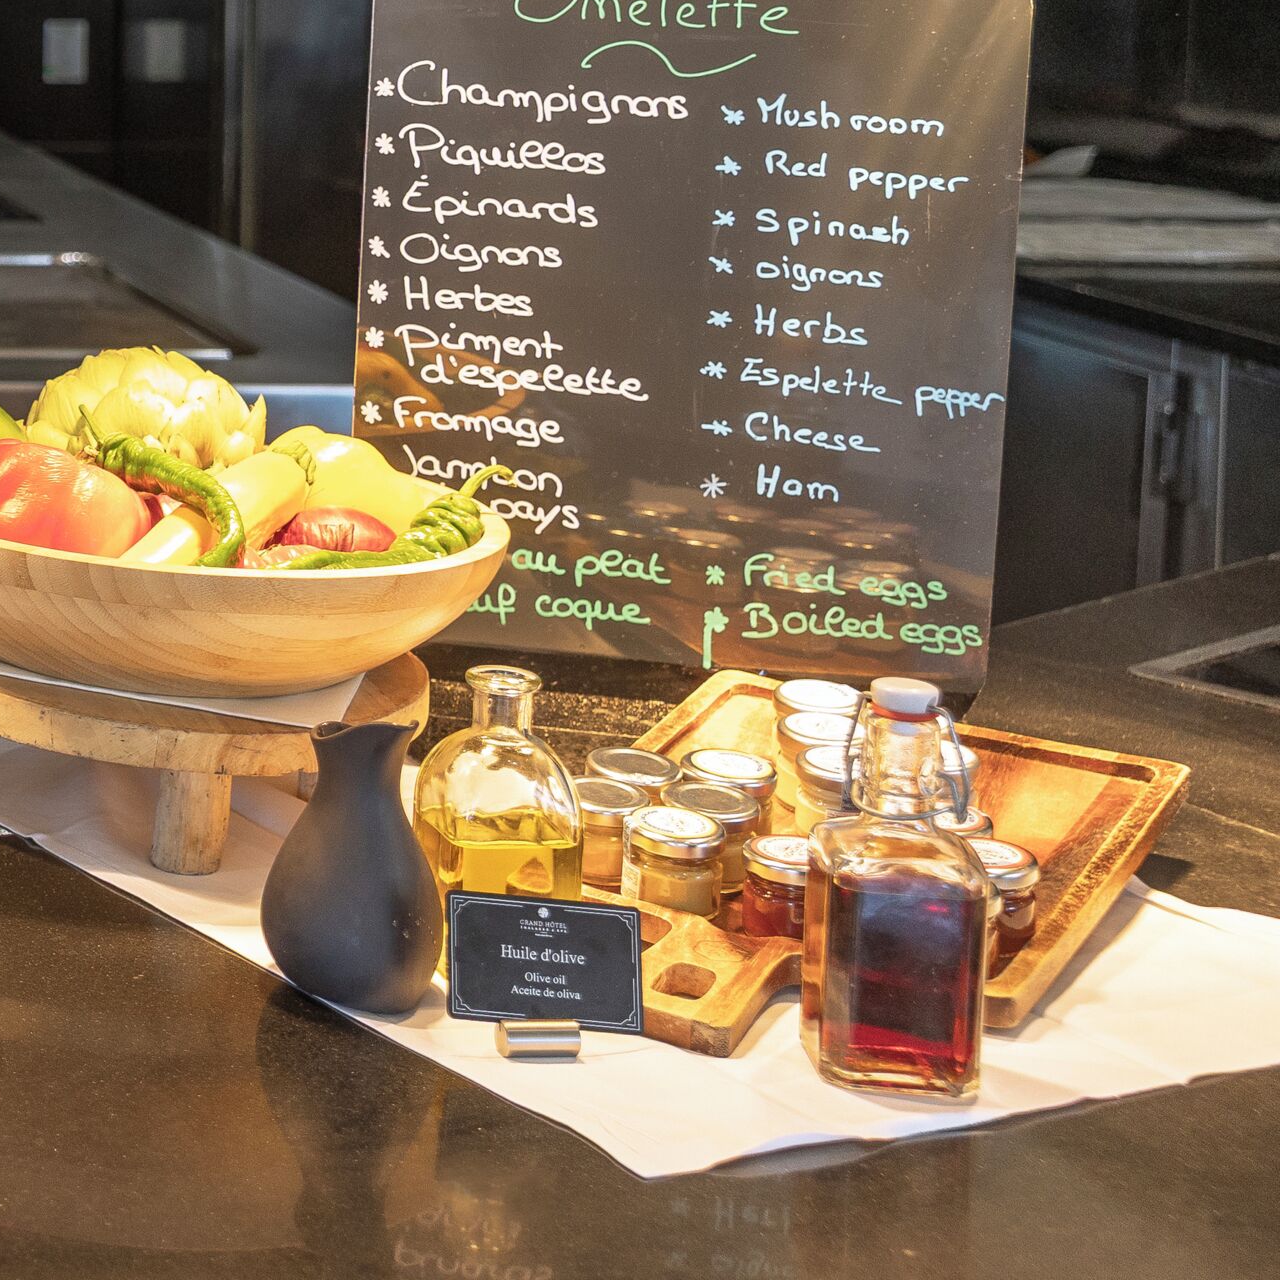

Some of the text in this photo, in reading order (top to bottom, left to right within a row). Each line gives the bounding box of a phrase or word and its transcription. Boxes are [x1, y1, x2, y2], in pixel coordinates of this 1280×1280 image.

[397, 59, 688, 123] Champignons
[398, 123, 606, 176] Piquillos
[764, 149, 970, 200] Red pepper
[399, 232, 563, 273] Oignons
[403, 275, 534, 317] Herbes
[393, 322, 565, 367] Piment
[754, 303, 868, 346] Herbs
[393, 395, 565, 447] Fromage
[744, 411, 881, 453] Cheese
[511, 548, 672, 588] au plat
[743, 553, 948, 609] Fried eggs
[534, 594, 652, 631] coque
[741, 602, 983, 656] Boiled eggs
[519, 919, 568, 930] GRAND HÔTEL
[501, 944, 586, 965] Huile d'olive
[511, 985, 581, 1000] Aceite de oliva
[524, 971, 566, 985] Olive oil
